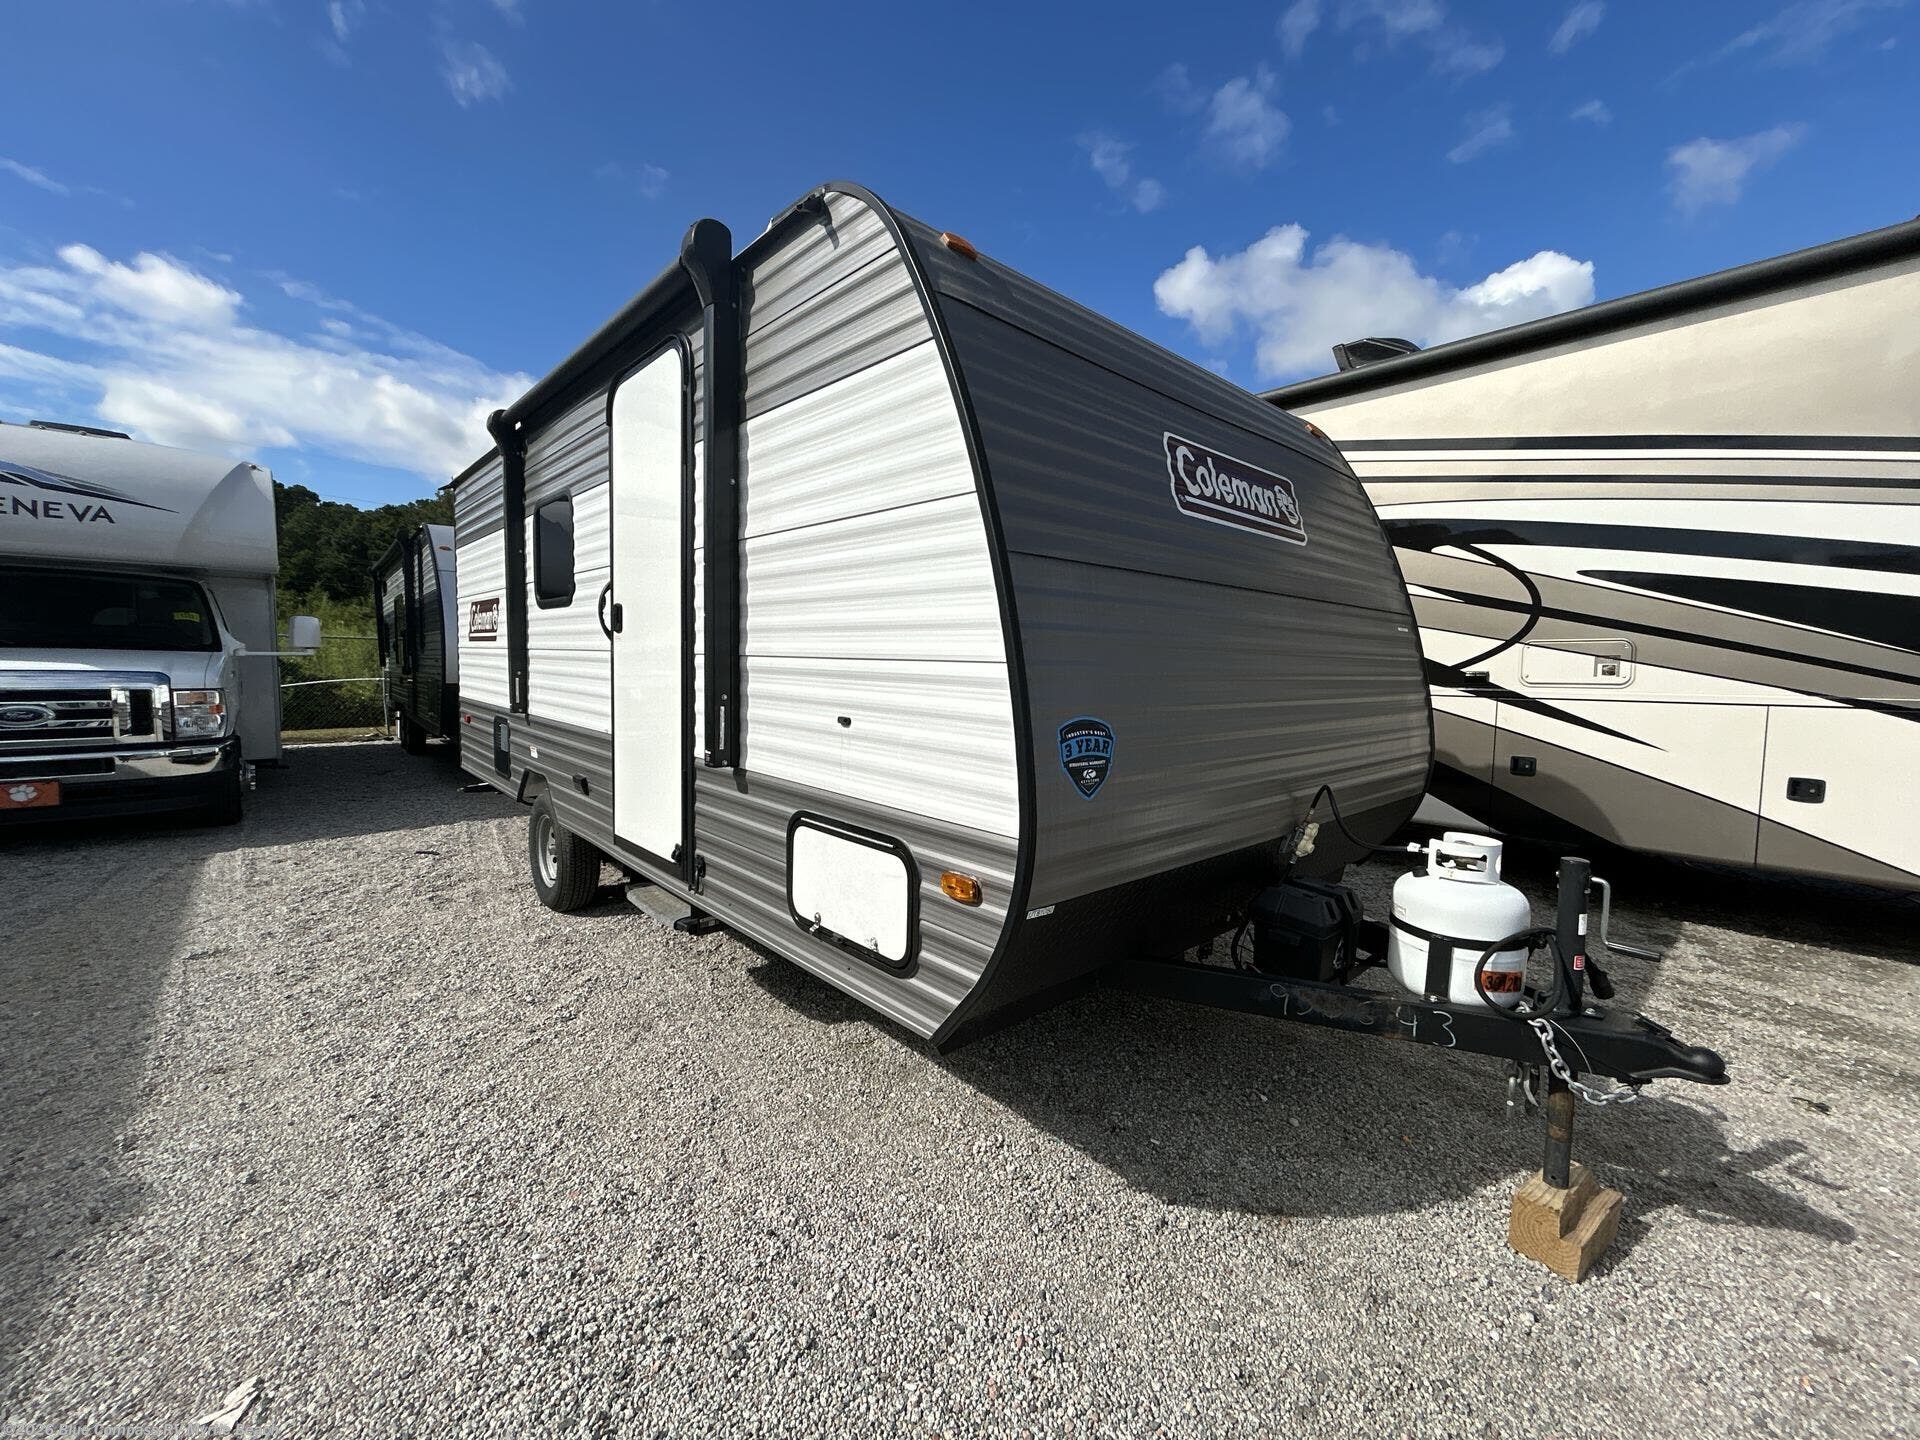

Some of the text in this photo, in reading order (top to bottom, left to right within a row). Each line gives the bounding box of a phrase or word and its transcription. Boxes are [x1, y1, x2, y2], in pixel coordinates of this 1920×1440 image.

[1176, 446, 1281, 518] Coleman
[1064, 738, 1110, 758] 3 YEAR
